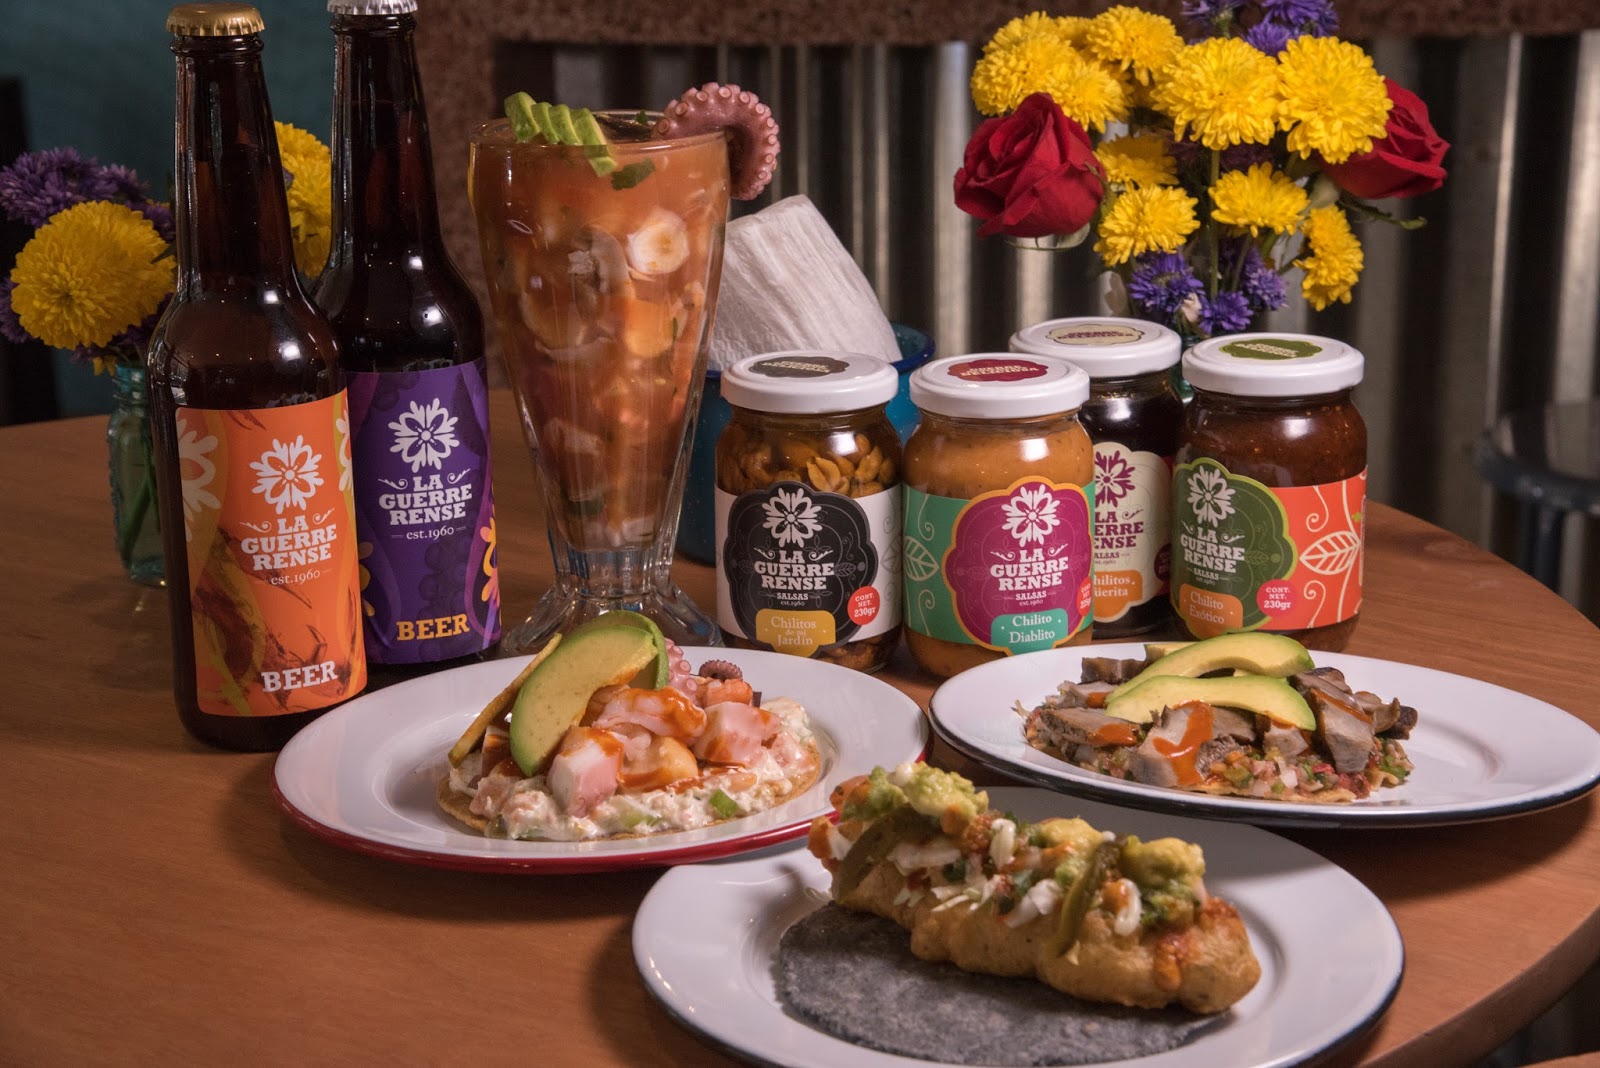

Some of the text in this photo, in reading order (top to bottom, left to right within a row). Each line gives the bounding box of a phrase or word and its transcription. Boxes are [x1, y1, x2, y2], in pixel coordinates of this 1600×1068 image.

[413, 474, 443, 492] LA
[379, 484, 472, 509] GUERRE
[390, 502, 466, 525] RENSE
[1095, 511, 1118, 523] LA
[277, 515, 309, 534] LA
[1095, 521, 1144, 536] ERRE
[241, 523, 337, 554] GUERRE
[406, 525, 454, 540] est.1960
[1197, 526, 1218, 543] LA
[1095, 535, 1136, 549] ENSE
[1180, 534, 1245, 560] GUERRE
[252, 543, 332, 571] RENSE
[779, 550, 805, 563] LA
[1019, 548, 1045, 562] LA
[1184, 548, 1236, 573] RENSE
[754, 561, 835, 576] GUERRE
[990, 557, 1069, 578] GUERRE
[1193, 568, 1219, 580] SALSAS
[271, 568, 320, 585] est.1960
[761, 576, 827, 590] RENSE
[999, 572, 1062, 591] RENSE
[1094, 575, 1130, 585] hilitos
[776, 592, 809, 600] SALSAS
[1015, 590, 1047, 600] SALSAS
[1094, 588, 1128, 597] üerita
[1190, 591, 1224, 610] Chilito
[1263, 600, 1291, 610] 230gr
[854, 607, 876, 617] 230gr
[1189, 604, 1225, 624] Exótico
[396, 613, 470, 641] BEER
[771, 616, 816, 629] Chilitos
[1012, 614, 1052, 627] Chilito
[778, 634, 813, 646] Jardín
[1009, 629, 1055, 643] Diablito
[261, 660, 338, 692] BEER
